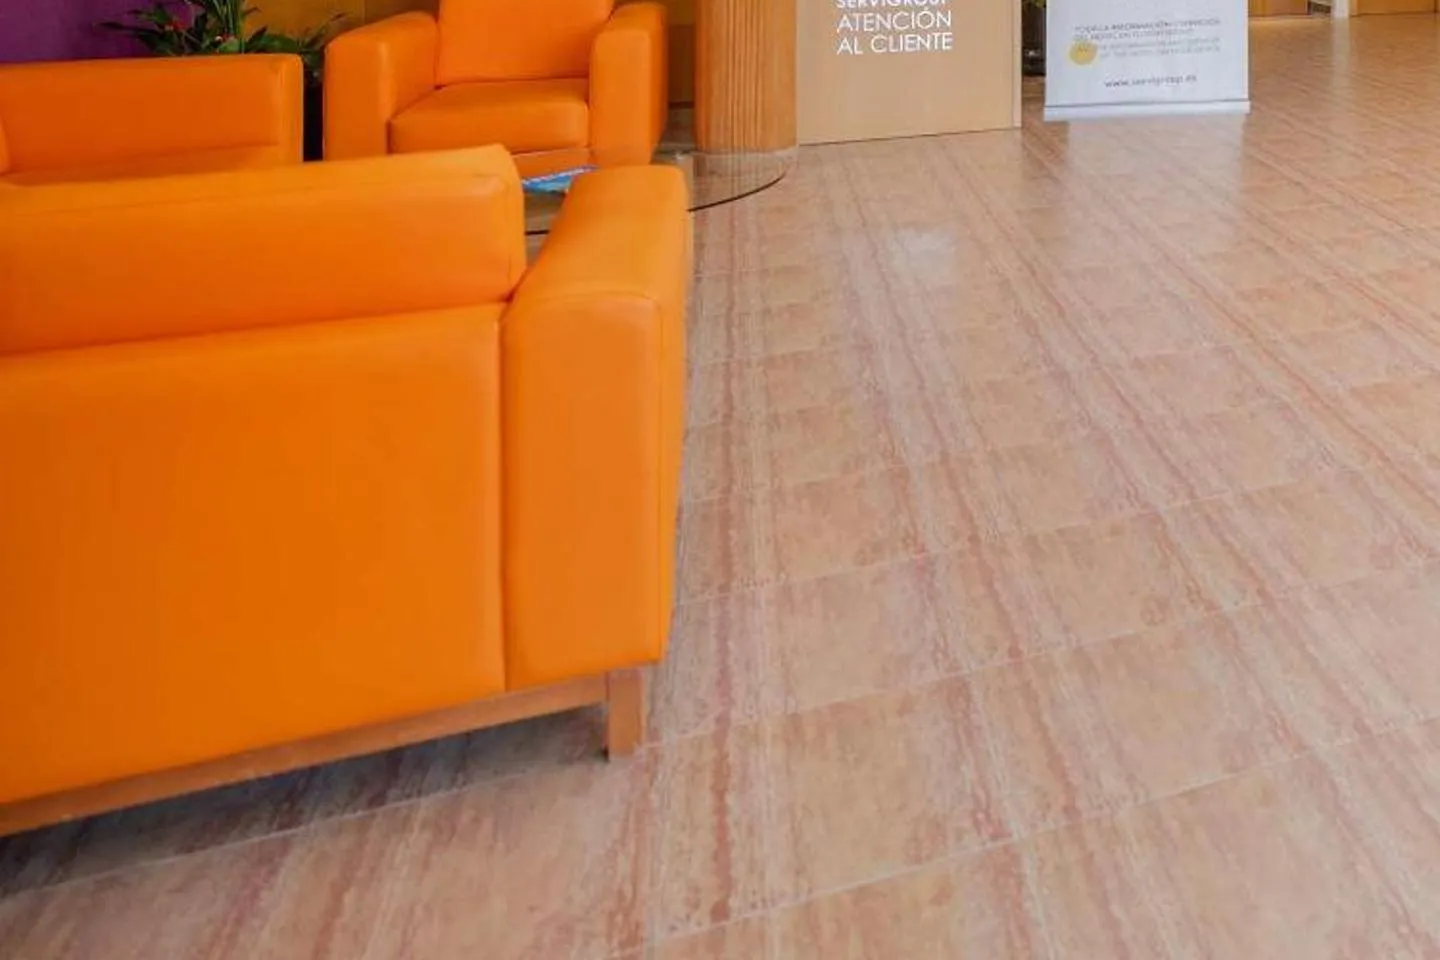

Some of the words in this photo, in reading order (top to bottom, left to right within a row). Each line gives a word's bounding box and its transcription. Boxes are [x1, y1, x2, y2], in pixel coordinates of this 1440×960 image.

[836, 7, 951, 32] ATENCIÓN
[836, 36, 863, 55] AL
[870, 32, 953, 53] CLIENTE
